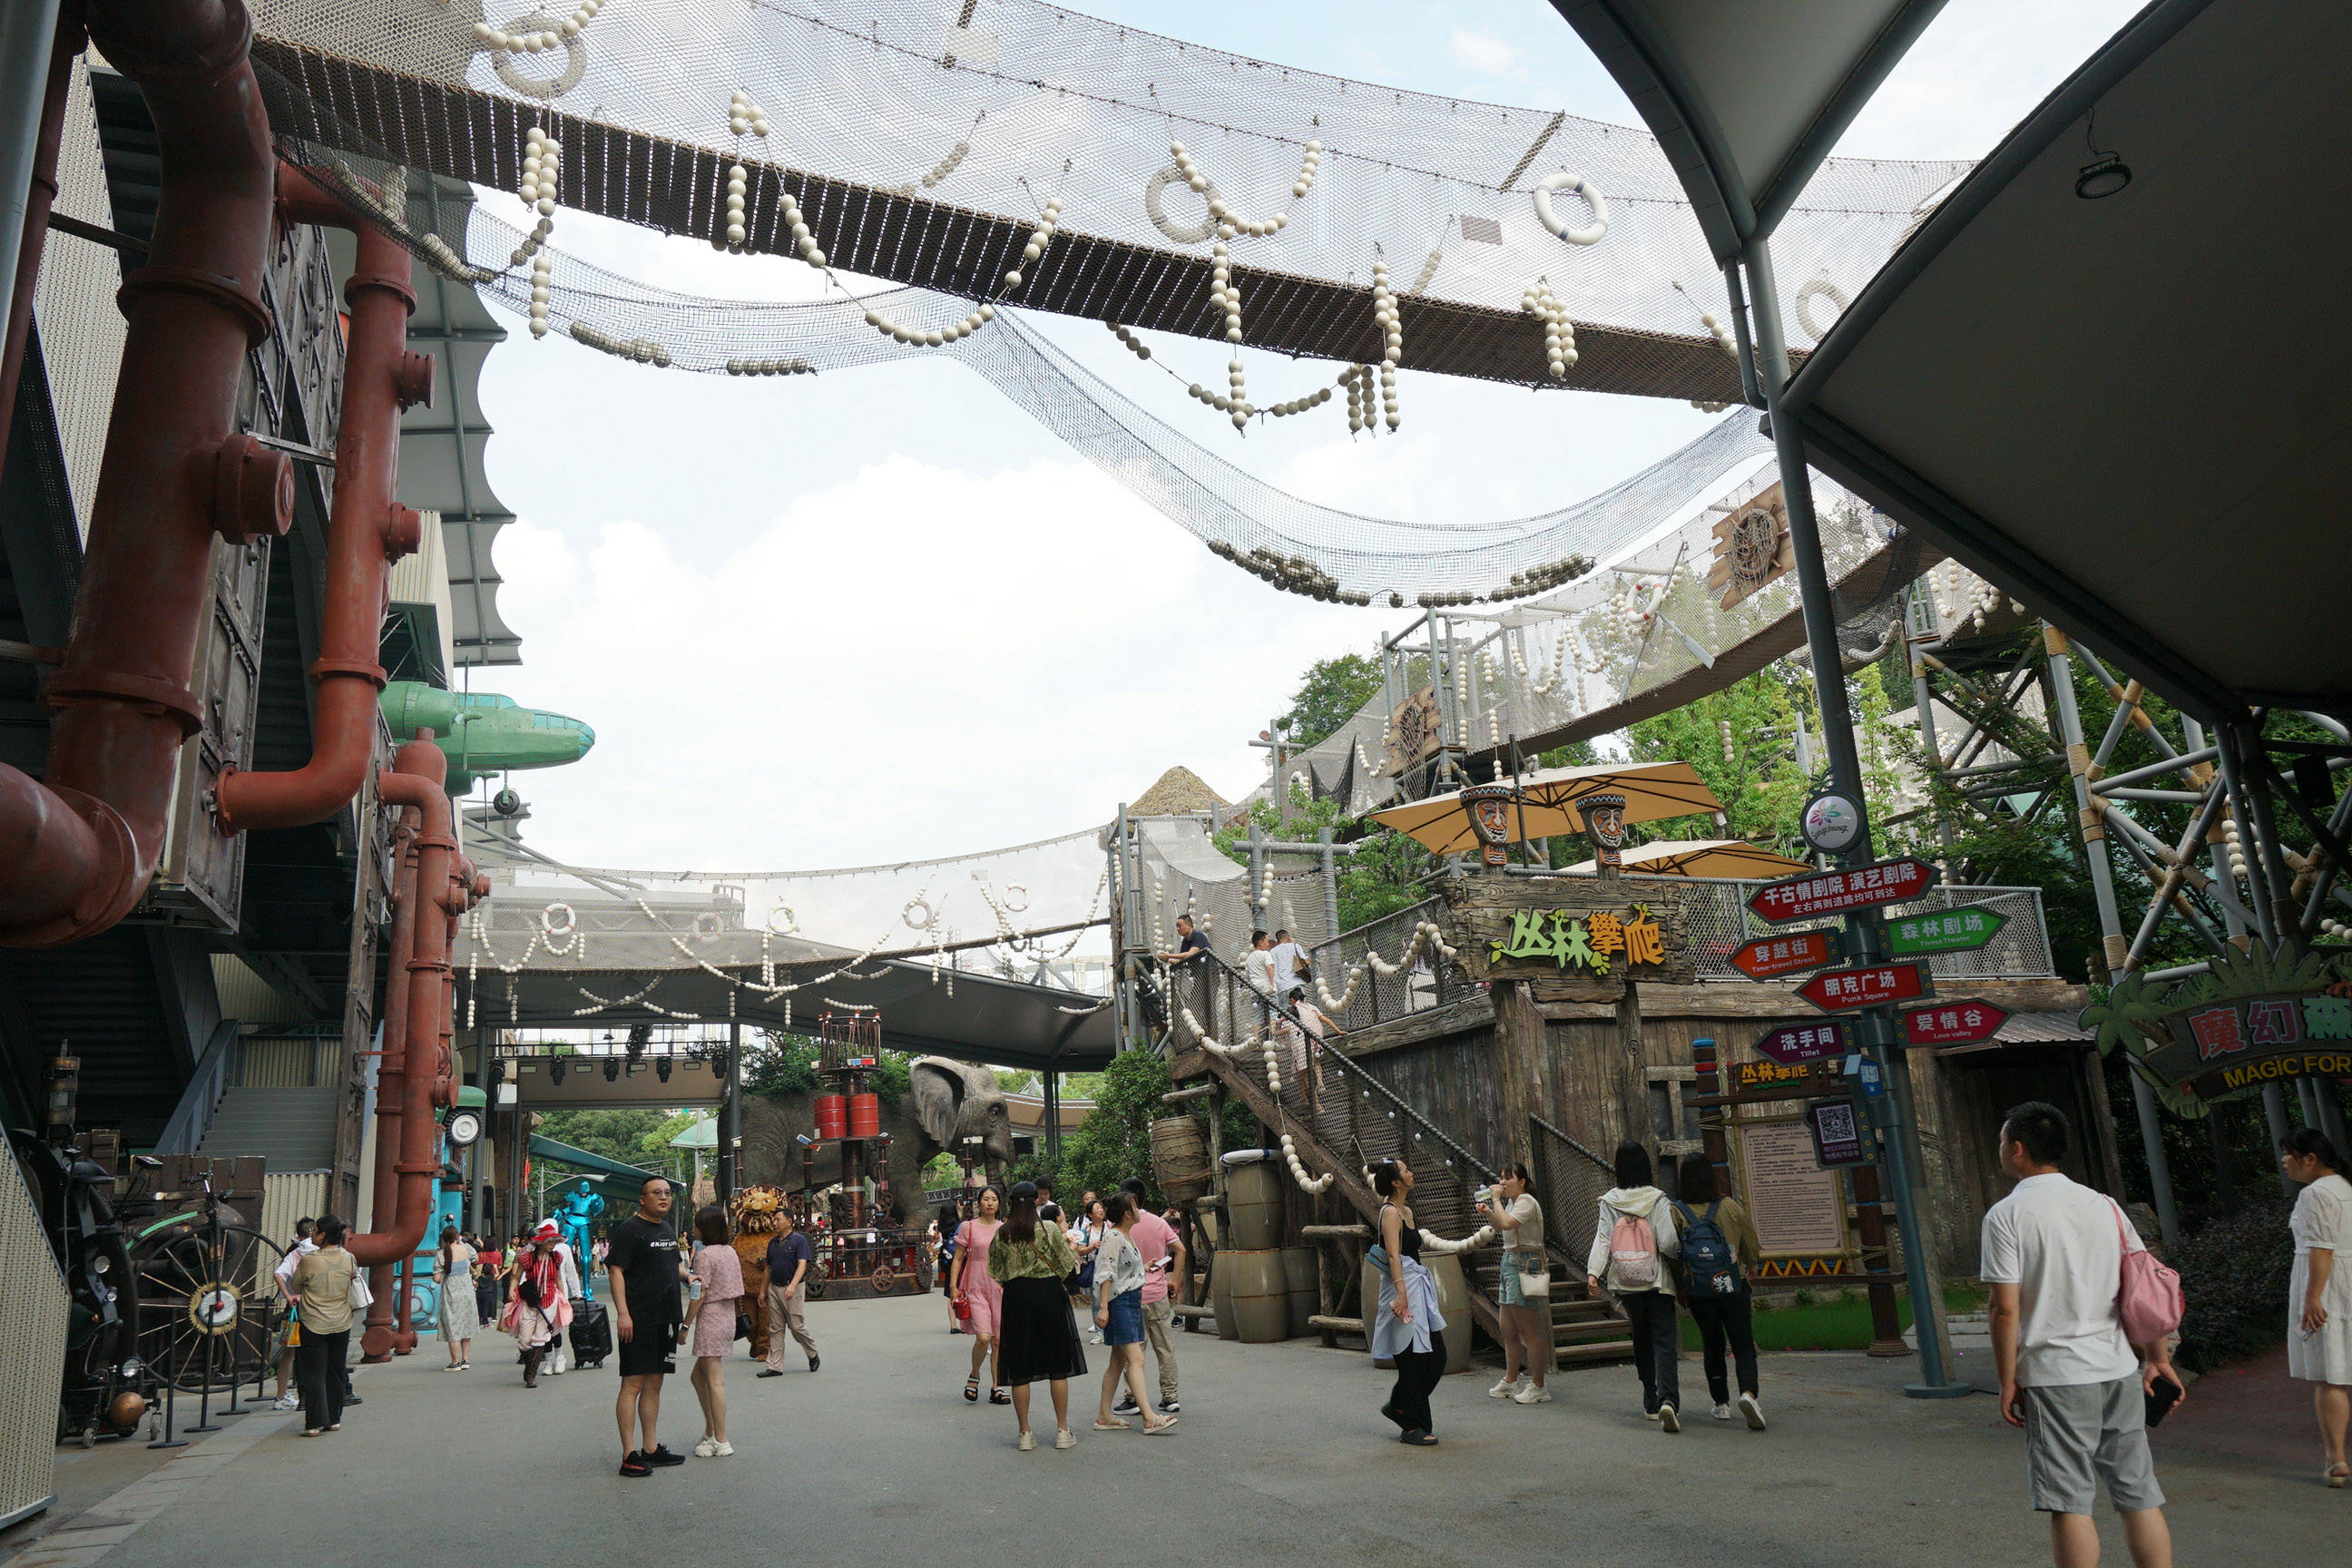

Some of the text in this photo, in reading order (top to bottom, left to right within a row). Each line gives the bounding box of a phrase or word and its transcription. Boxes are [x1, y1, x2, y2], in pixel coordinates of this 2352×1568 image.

[1764, 863, 1917, 906] 千古情剧院 演艺剧院
[1497, 907, 1666, 969] 丛林攀爬
[1900, 915, 1984, 940] 森林剧场
[1754, 937, 1808, 964] 穿越街
[1751, 956, 1817, 974] Time-travel Street
[1824, 971, 1897, 996] 朋克广场
[1841, 992, 1890, 1004] Punk Square
[1916, 1009, 1984, 1032] 爱情谷
[1780, 1026, 1835, 1052] 洗手间
[1934, 1032, 1951, 1040] Love
[2222, 1057, 2300, 1089] MAGIC
